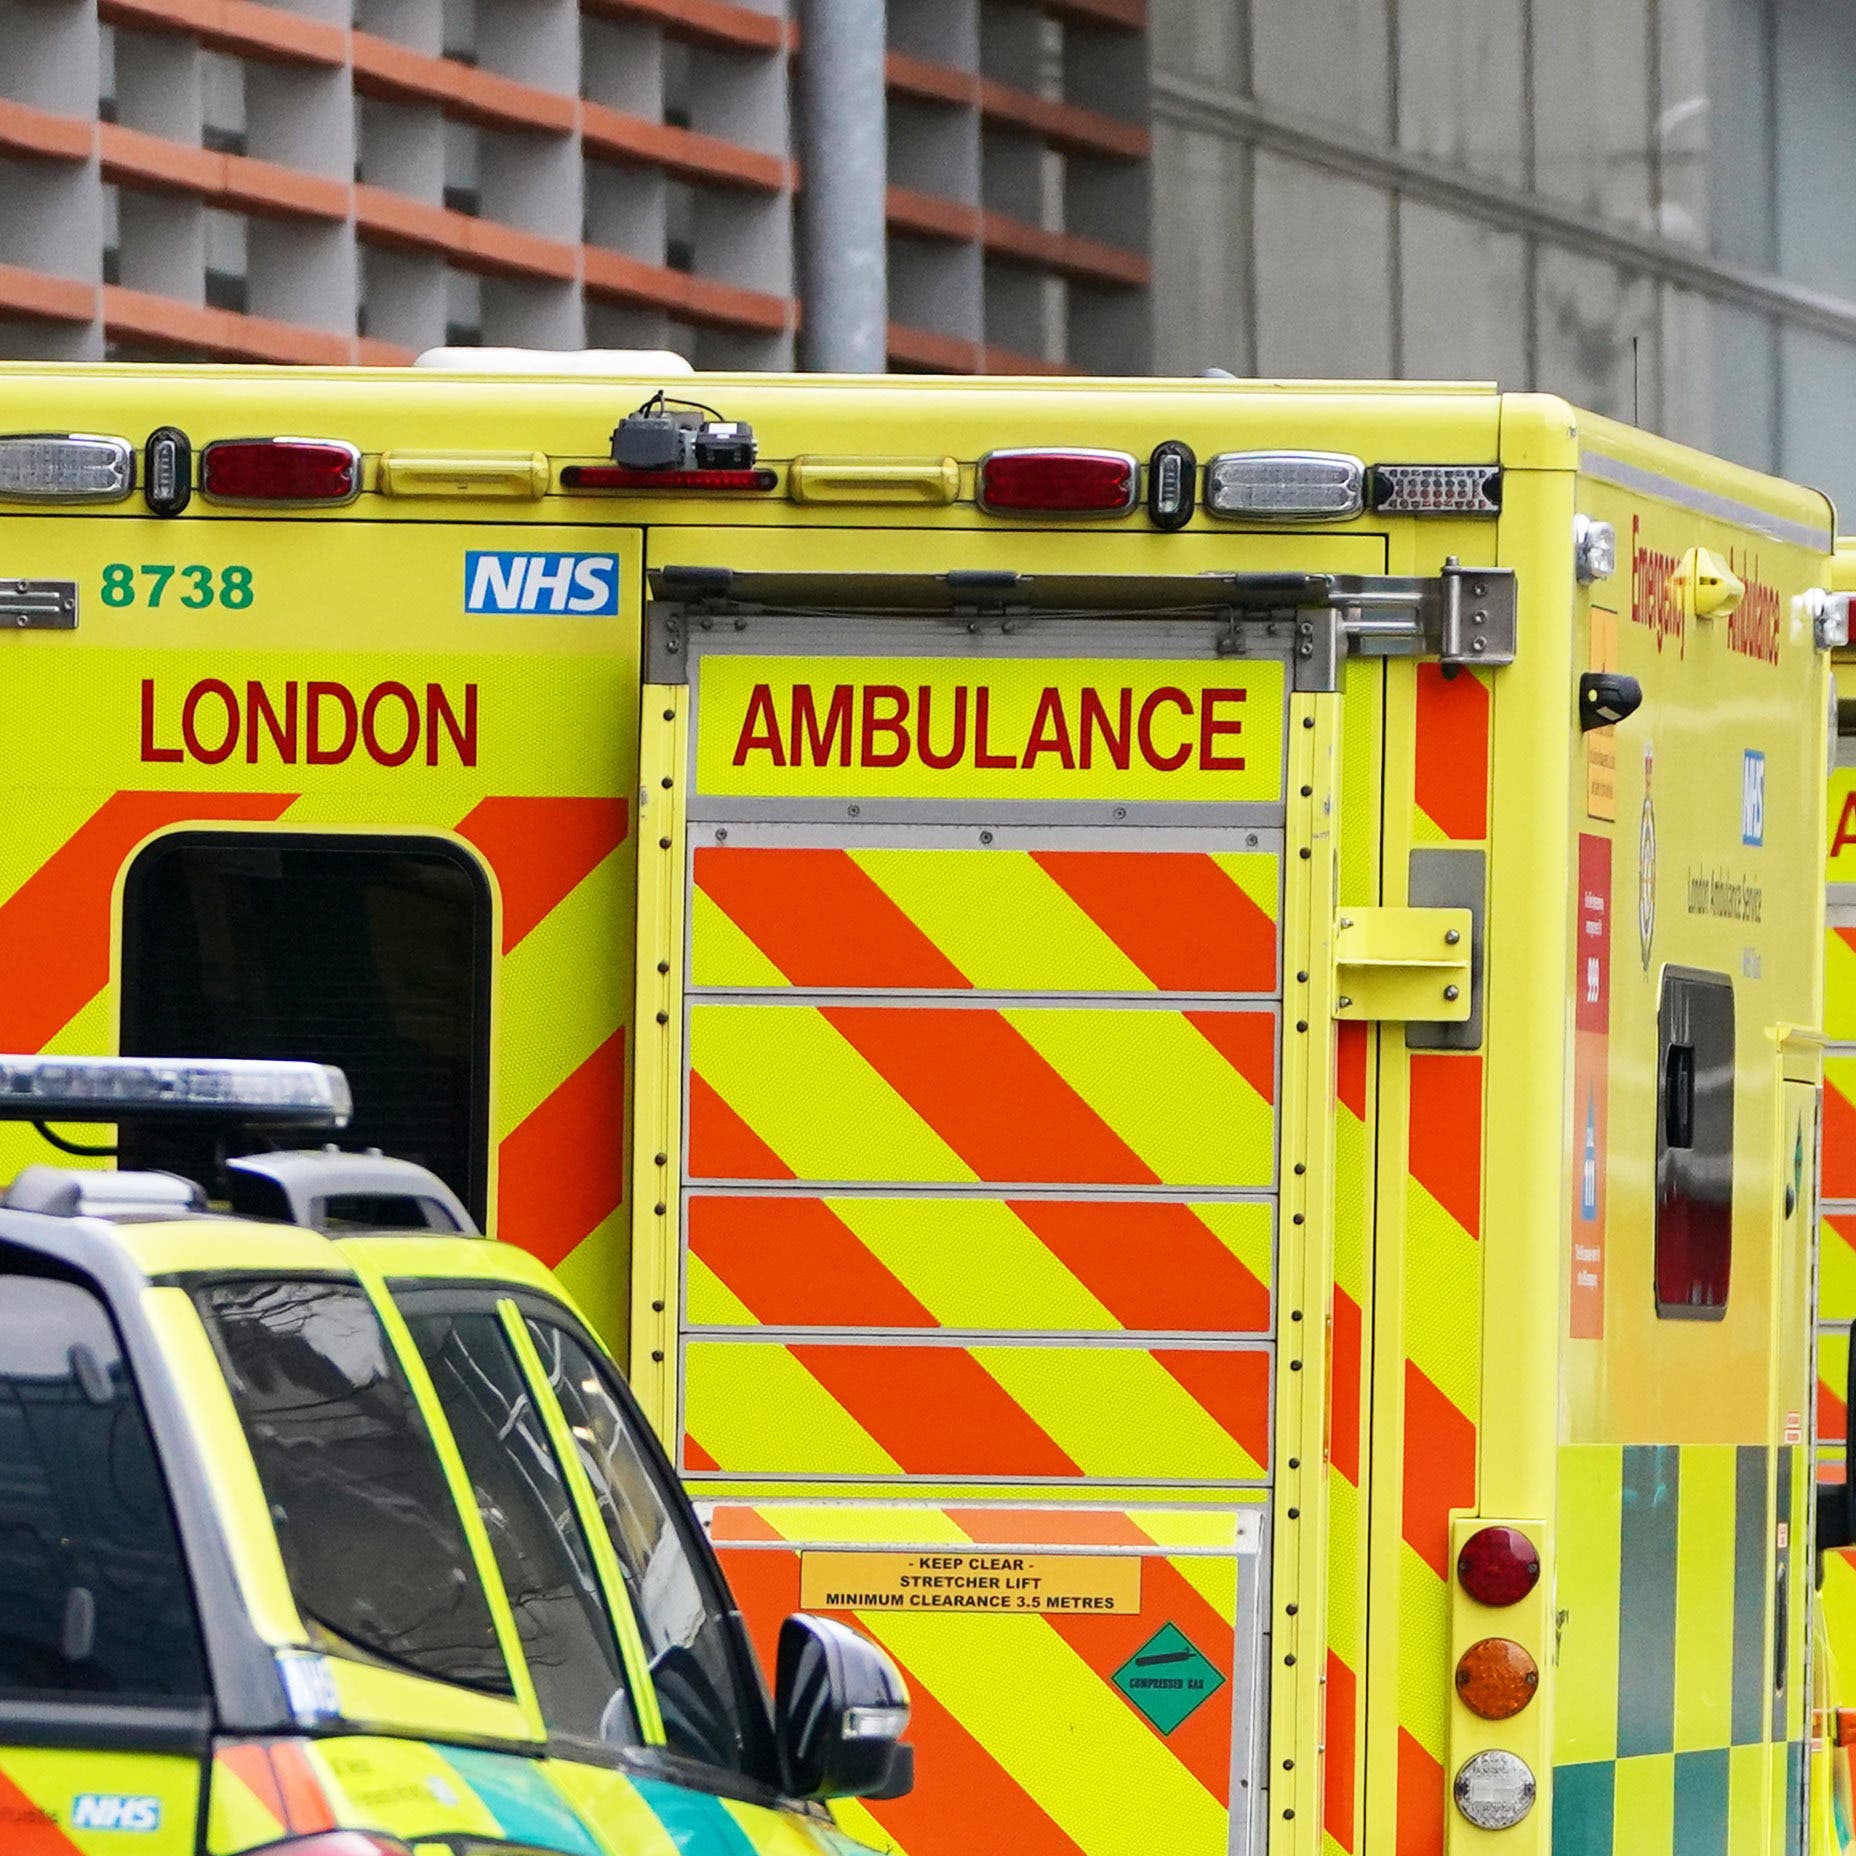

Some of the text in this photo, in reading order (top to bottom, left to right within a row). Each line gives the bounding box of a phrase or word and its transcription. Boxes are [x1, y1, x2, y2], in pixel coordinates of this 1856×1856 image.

[100, 563, 255, 609] 8738
[467, 556, 614, 613] NHS
[141, 679, 479, 767] LONDON
[732, 683, 1248, 772] AMBULANCE
[899, 1576, 1042, 1591] STRETCHER LIFT
[919, 1557, 964, 1571] KEEP
[968, 1558, 1024, 1572] CLEAR
[826, 1593, 1115, 1609] MINIMUM CLEARANCE 3.5 METRES
[76, 1797, 158, 1829] NHS
